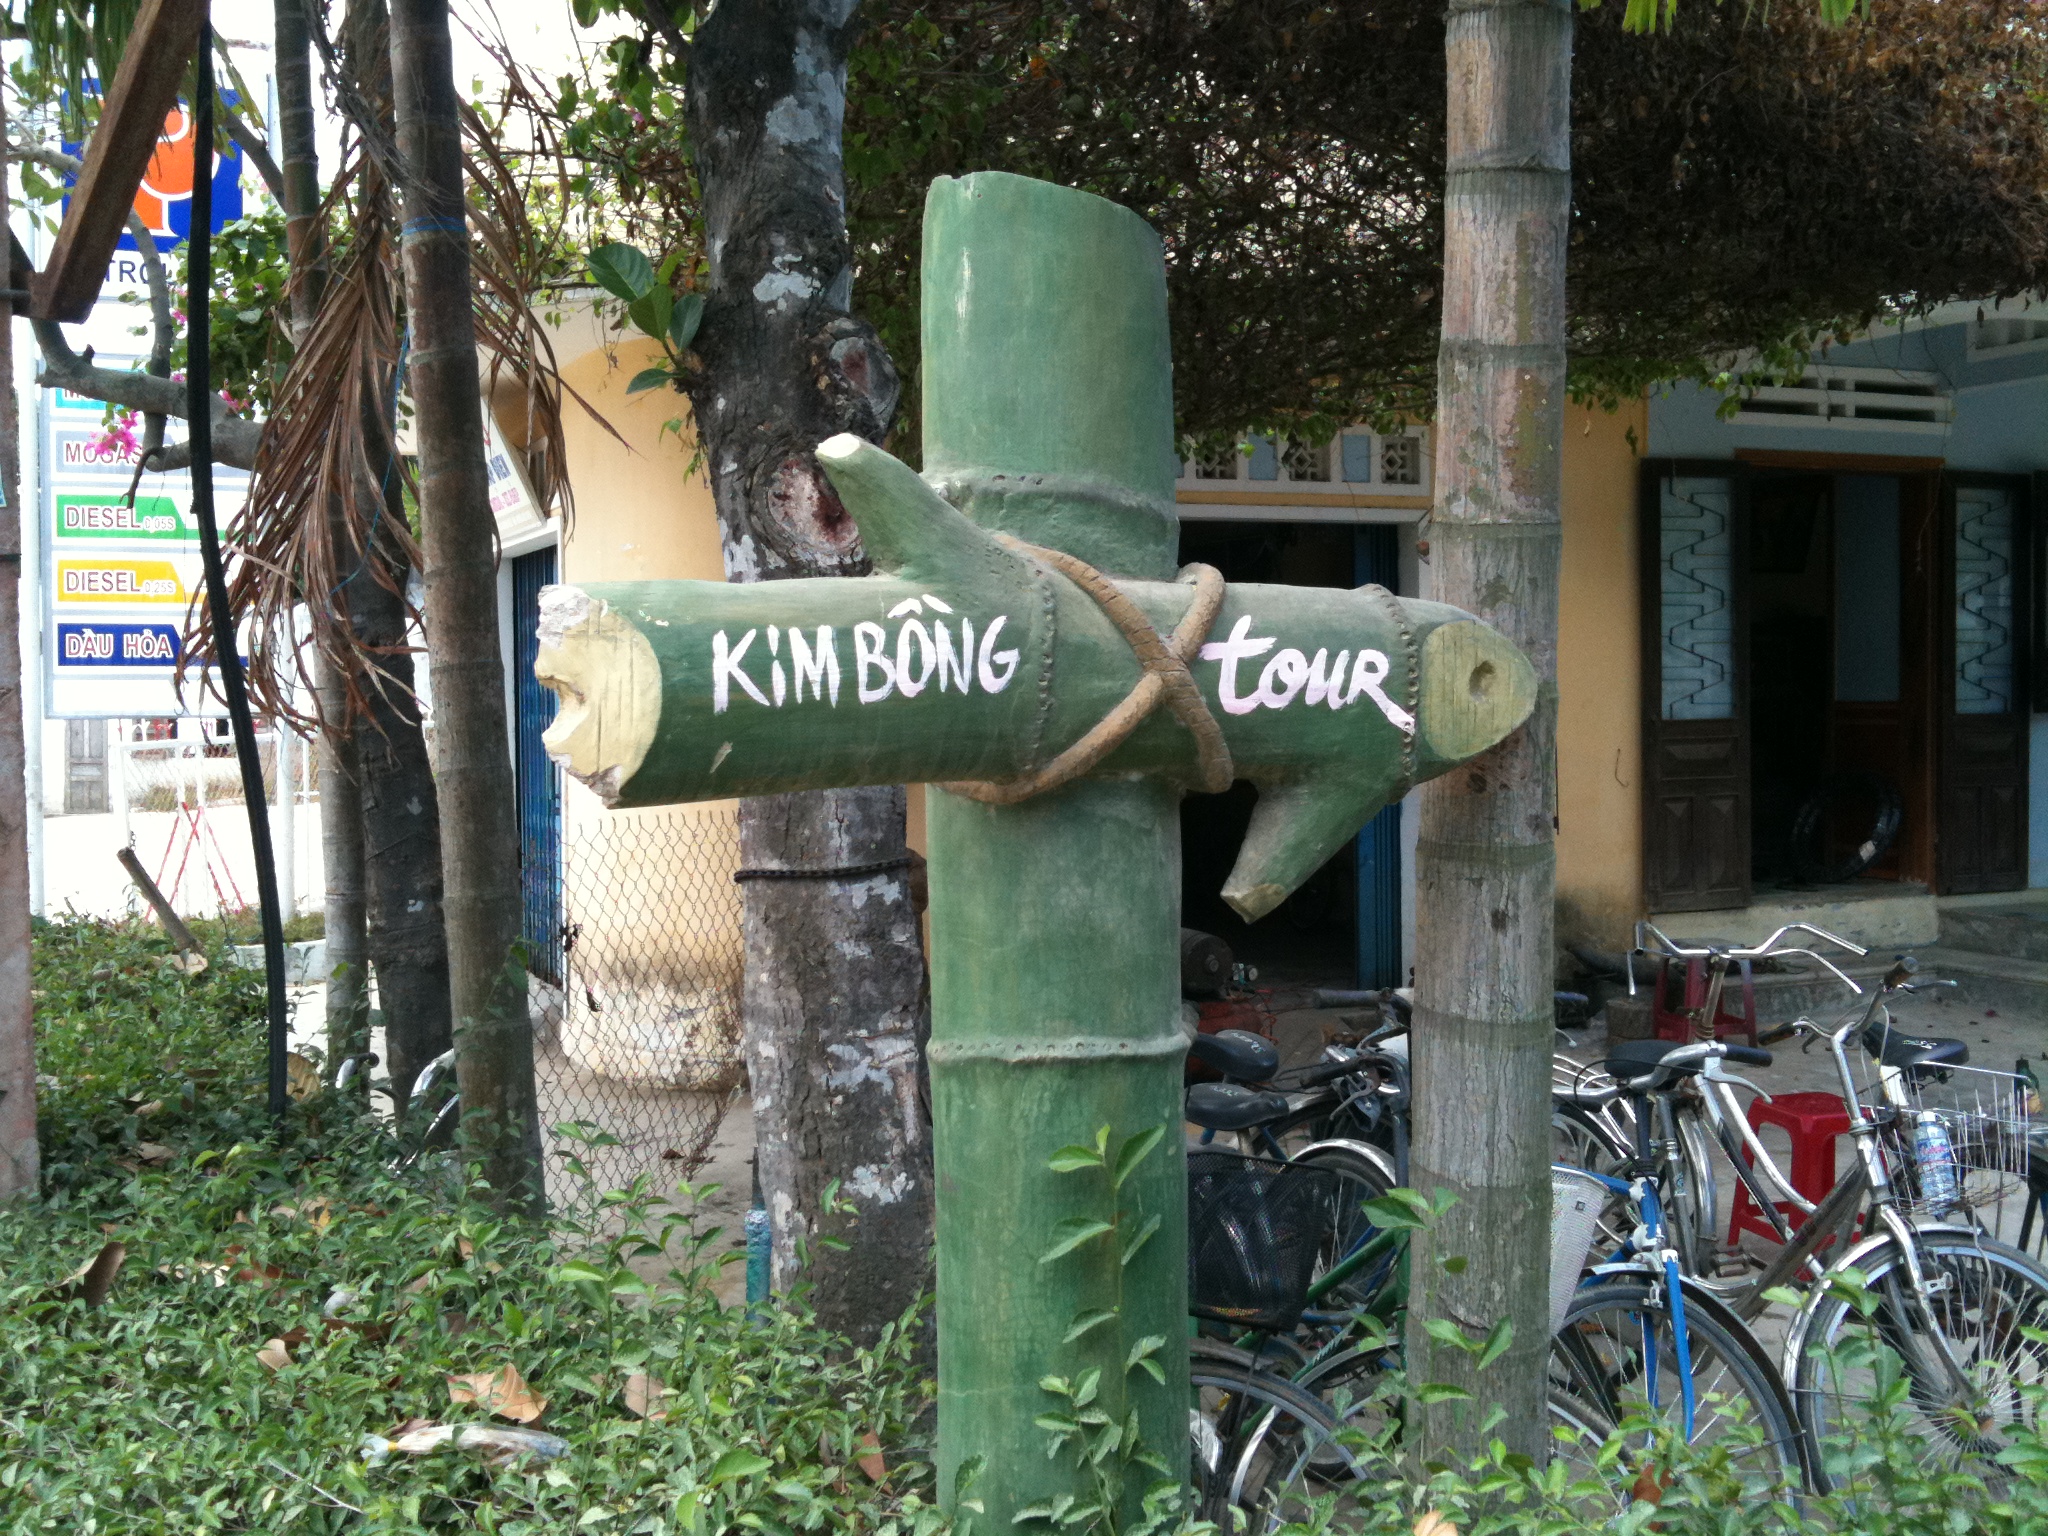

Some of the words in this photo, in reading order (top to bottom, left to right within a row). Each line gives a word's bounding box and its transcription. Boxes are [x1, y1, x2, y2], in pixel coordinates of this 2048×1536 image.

[66, 507, 141, 529] DIESEL
[66, 571, 141, 593] DIESEL
[64, 628, 114, 658] DẦU
[122, 629, 174, 658] HỎA
